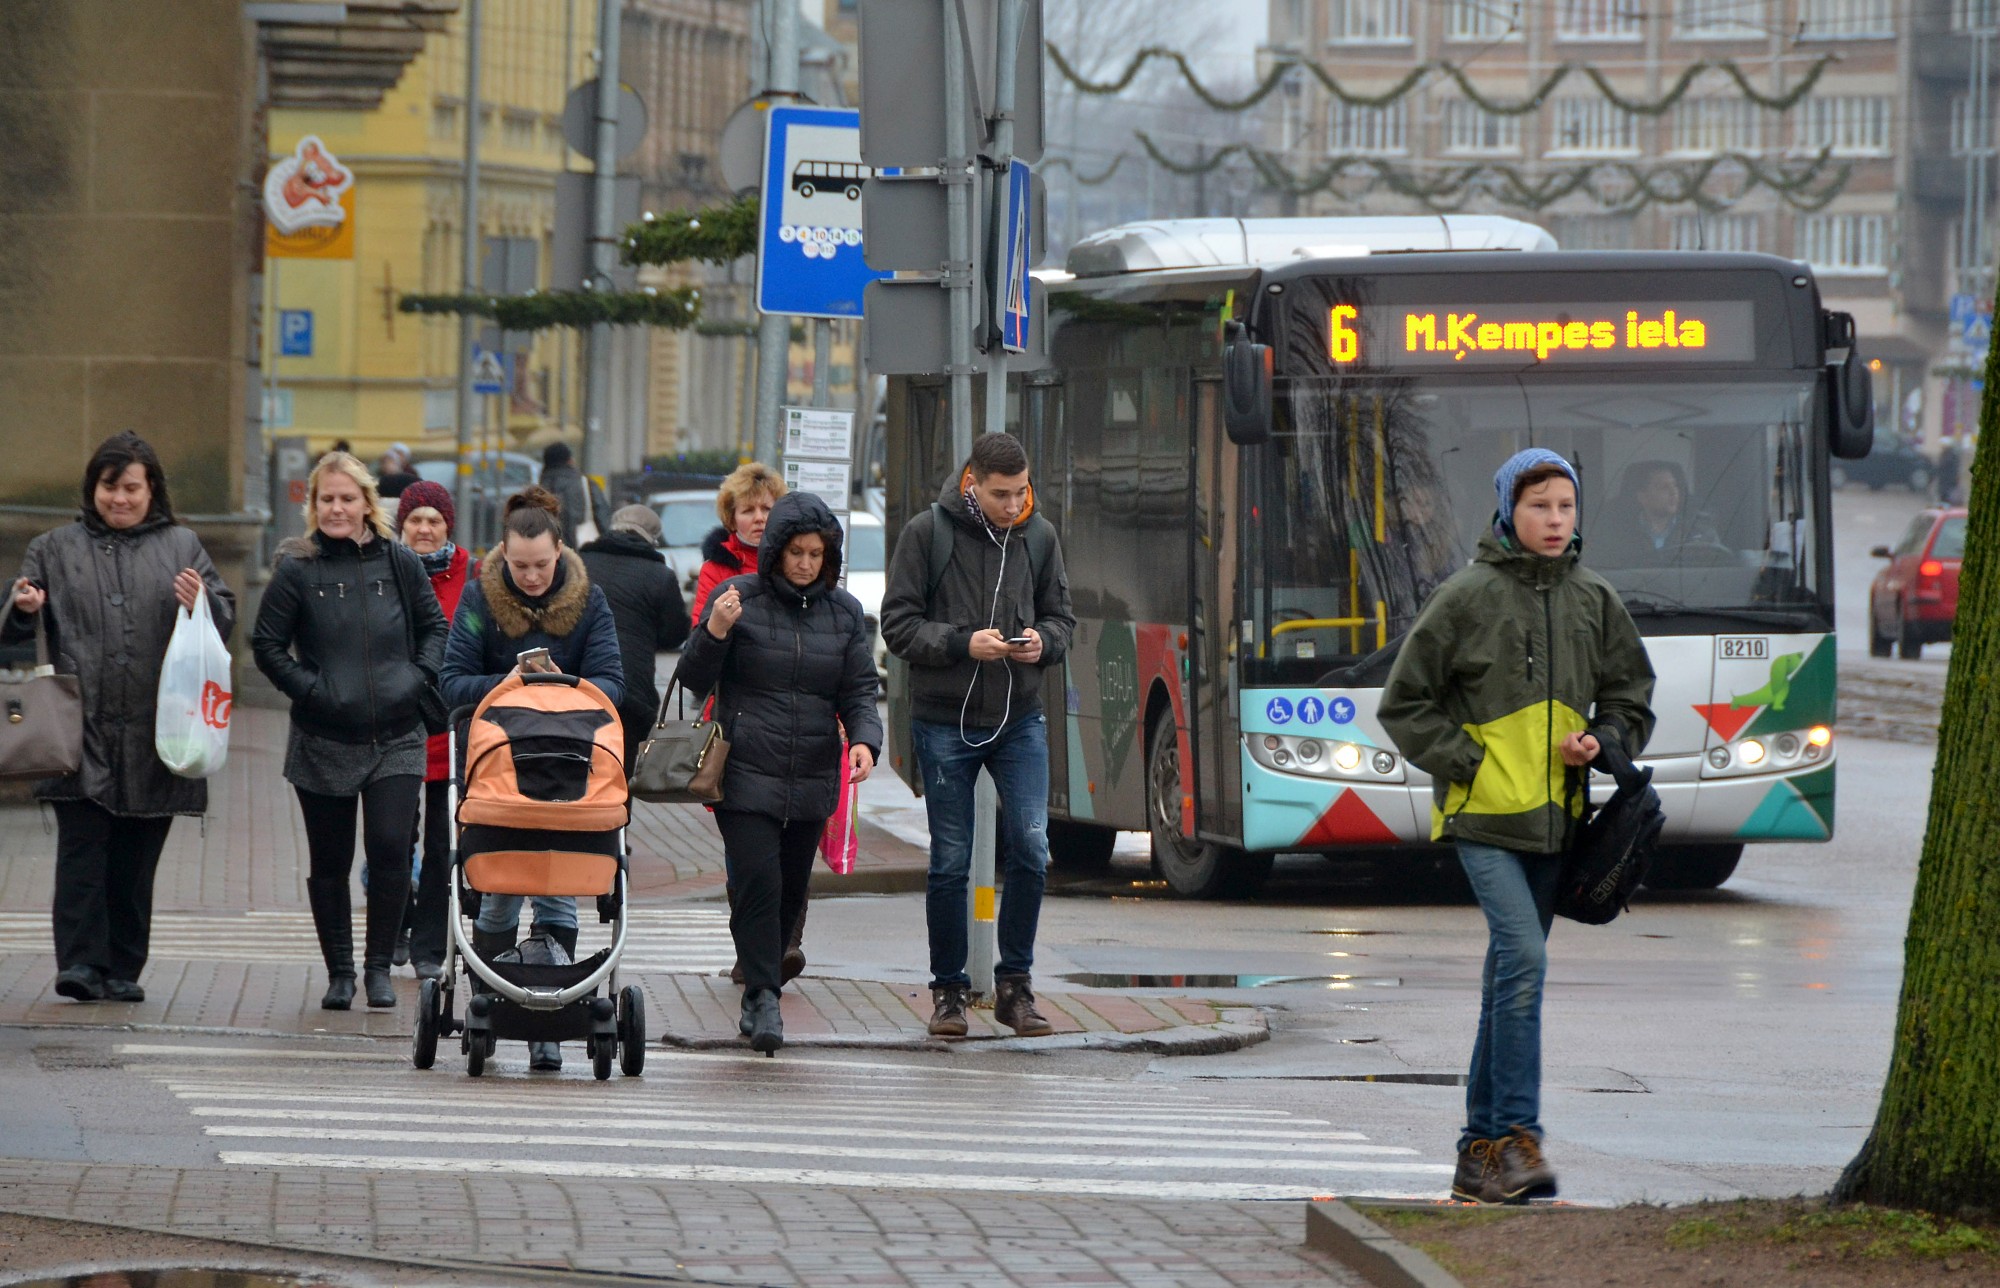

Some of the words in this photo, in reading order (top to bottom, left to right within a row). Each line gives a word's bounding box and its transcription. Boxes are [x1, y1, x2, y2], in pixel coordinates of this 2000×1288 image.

[784, 229, 791, 238] 3
[799, 230, 807, 240] 4
[815, 231, 826, 240] 10
[830, 231, 841, 240] 14
[847, 233, 858, 242] 15
[285, 313, 308, 341] P
[1330, 304, 1358, 363] 6
[1405, 311, 1616, 361] M.Ķempes
[1626, 309, 1706, 349] iela
[279, 449, 307, 480] P
[1724, 640, 1764, 657] 8210
